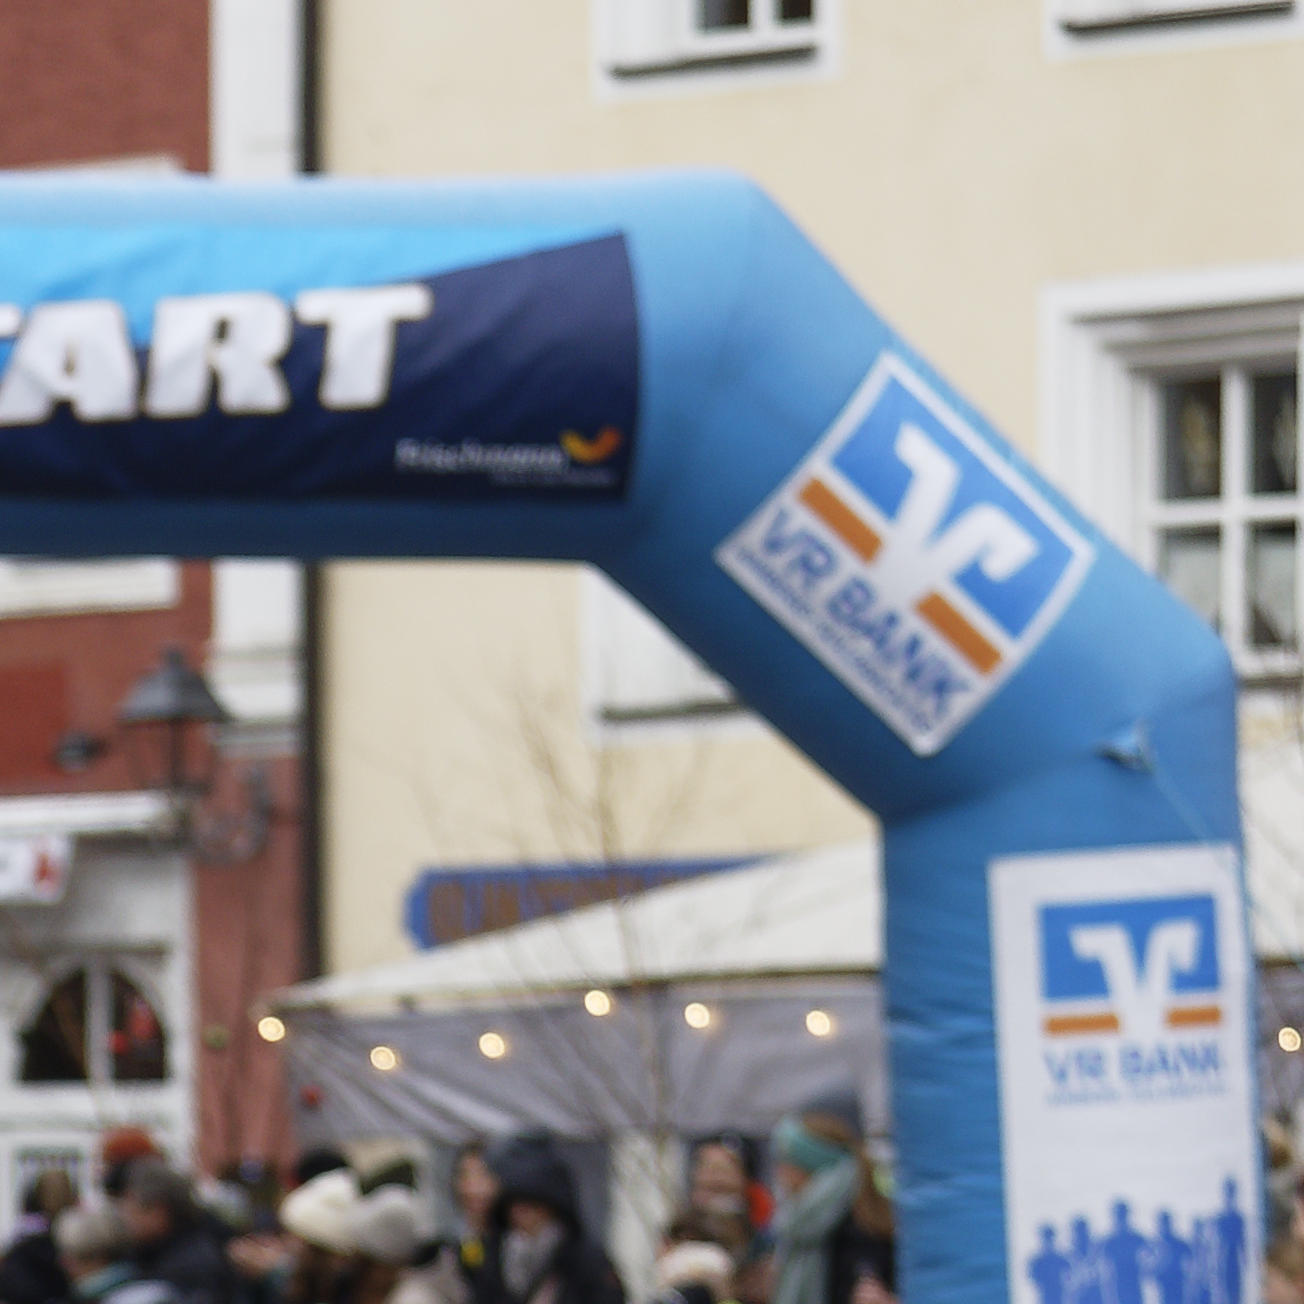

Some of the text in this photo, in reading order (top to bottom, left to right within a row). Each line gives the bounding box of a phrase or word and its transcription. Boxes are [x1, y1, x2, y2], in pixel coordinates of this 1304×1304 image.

[761, 506, 836, 593] VR
[827, 575, 973, 721] BANK
[1043, 1041, 1225, 1086] VR BANK
